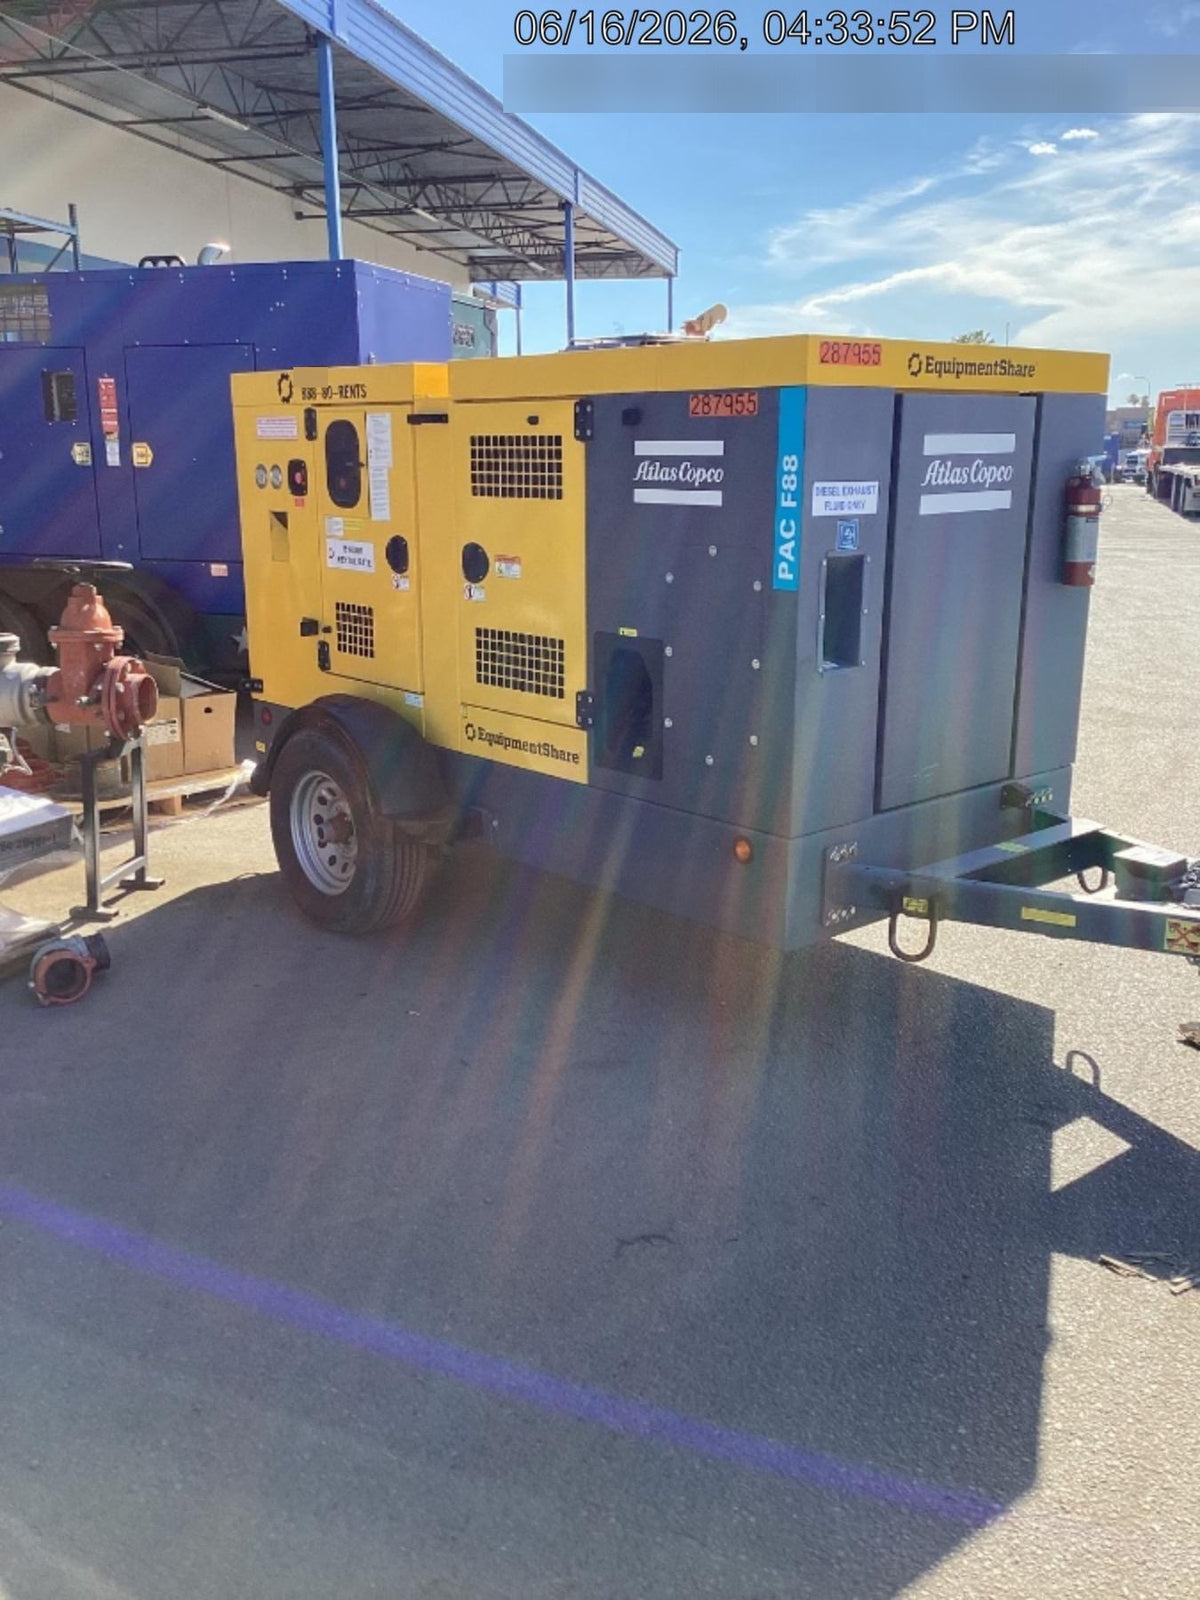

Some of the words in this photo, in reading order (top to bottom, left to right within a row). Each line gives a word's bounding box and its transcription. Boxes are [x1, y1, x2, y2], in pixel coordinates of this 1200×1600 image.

[820, 340, 881, 365] 287955
[925, 356, 1035, 378] EquipmentShare
[690, 392, 757, 415] 287955
[633, 460, 678, 481] Atlas
[678, 461, 725, 487] Copco
[781, 454, 799, 508] F88
[920, 459, 970, 486] Atlas
[970, 458, 1014, 488] Copco
[777, 518, 797, 580] PAC
[477, 726, 580, 764] EquipmentShare
